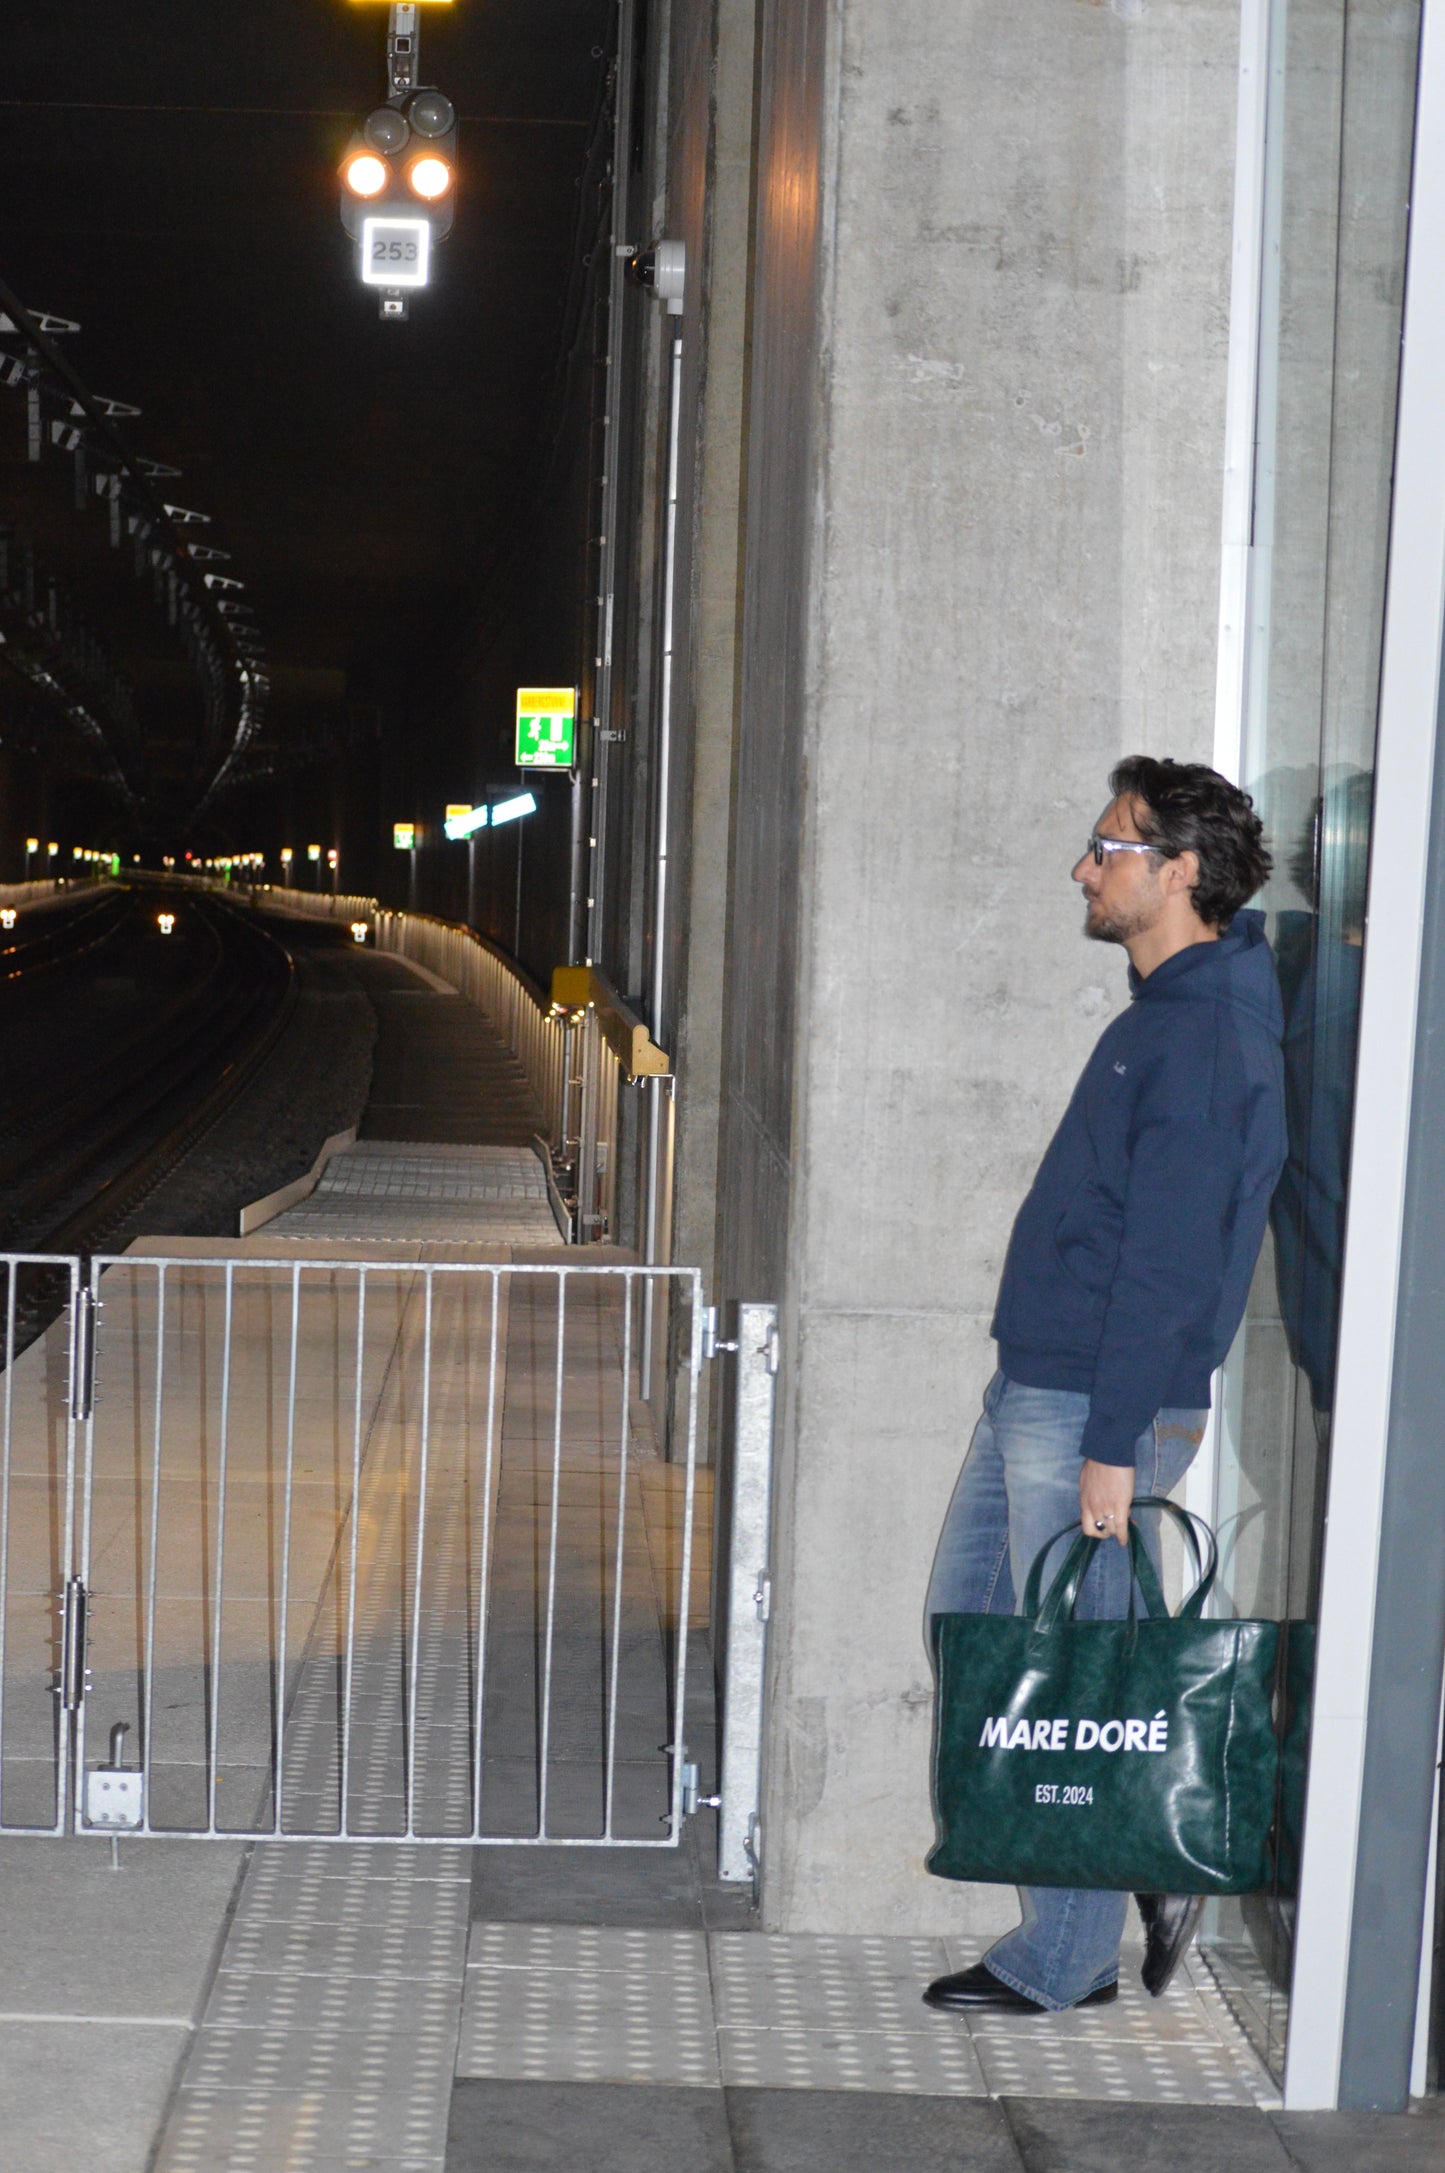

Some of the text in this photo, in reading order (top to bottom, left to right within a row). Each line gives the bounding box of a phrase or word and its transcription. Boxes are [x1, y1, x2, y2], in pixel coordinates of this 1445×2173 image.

[373, 241, 417, 261] 253
[979, 1709, 1168, 1753] MARE DORÉ
